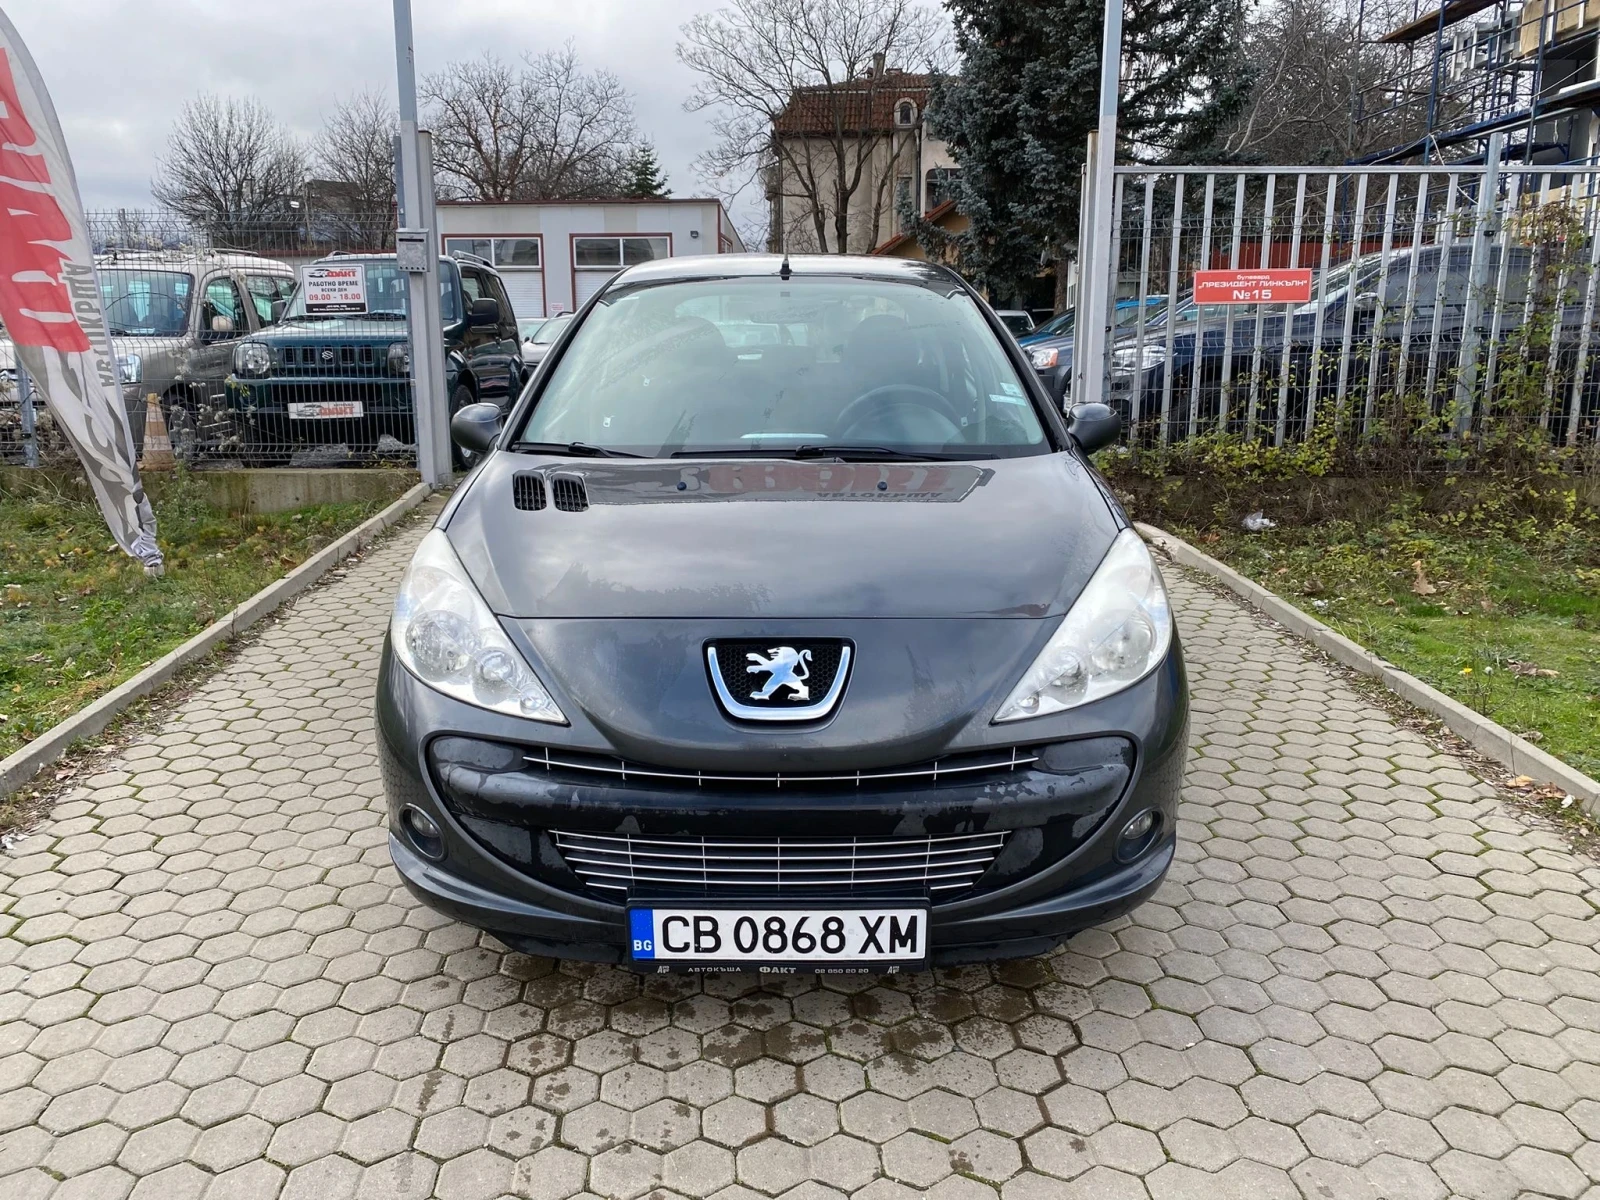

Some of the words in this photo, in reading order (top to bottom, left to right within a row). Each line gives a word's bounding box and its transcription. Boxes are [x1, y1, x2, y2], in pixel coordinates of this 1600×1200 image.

[308, 293, 331, 301] 09.00
[661, 914, 722, 954] CB
[732, 914, 847, 954] 0868
[857, 914, 918, 954] XM
[633, 939, 653, 952] BG
[758, 965, 797, 974] ФАКТ
